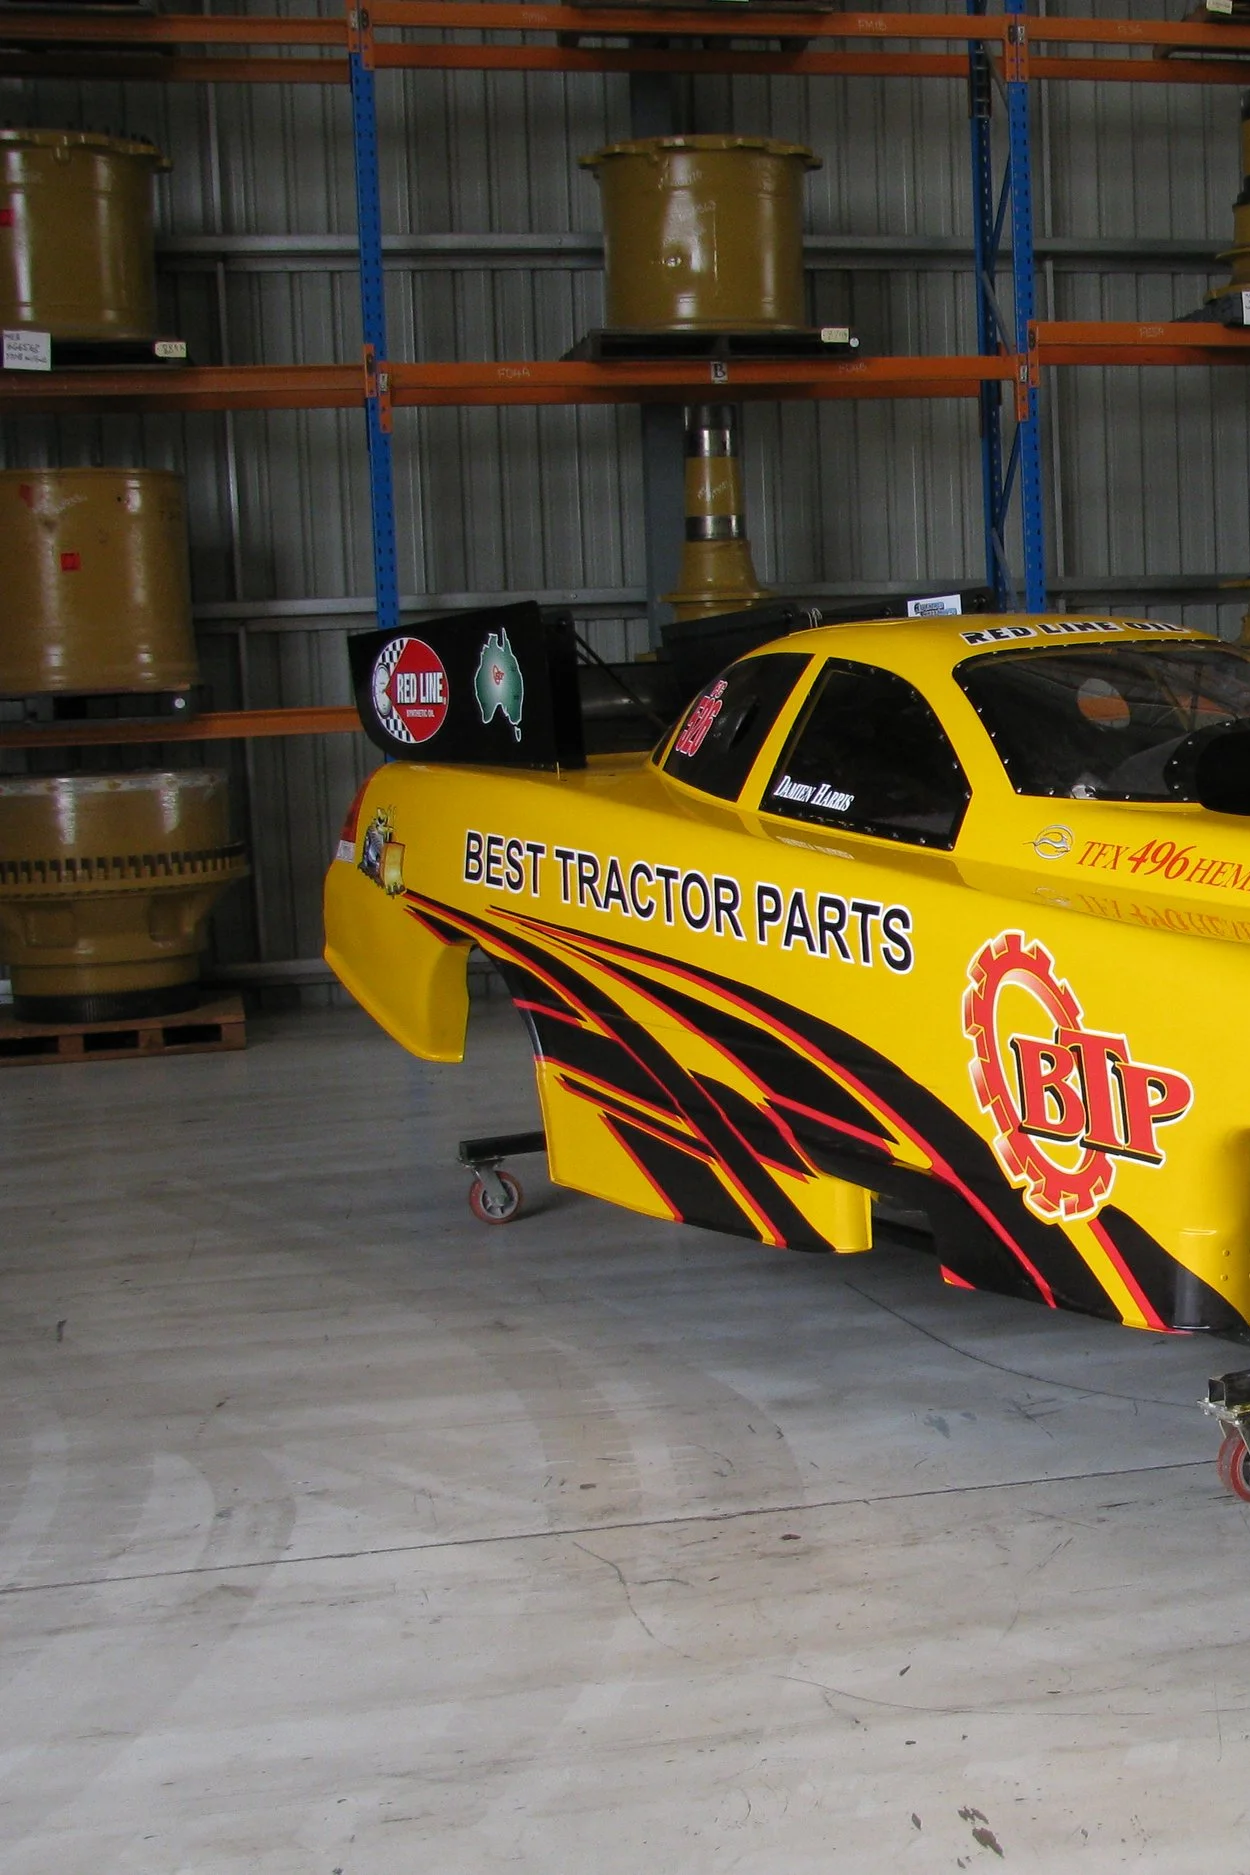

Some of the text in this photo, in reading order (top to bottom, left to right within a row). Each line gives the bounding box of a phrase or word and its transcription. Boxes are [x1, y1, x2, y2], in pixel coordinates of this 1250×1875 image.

[960, 621, 1191, 646] RED LINE OIL
[397, 672, 443, 704] RED LINE
[773, 775, 855, 812] DAMIEN HARRIS
[1077, 840, 1130, 871] TFX
[1128, 837, 1197, 880] 496
[464, 829, 915, 976] BEST TRACTOR PARTS
[1009, 1026, 1194, 1169] BTP
